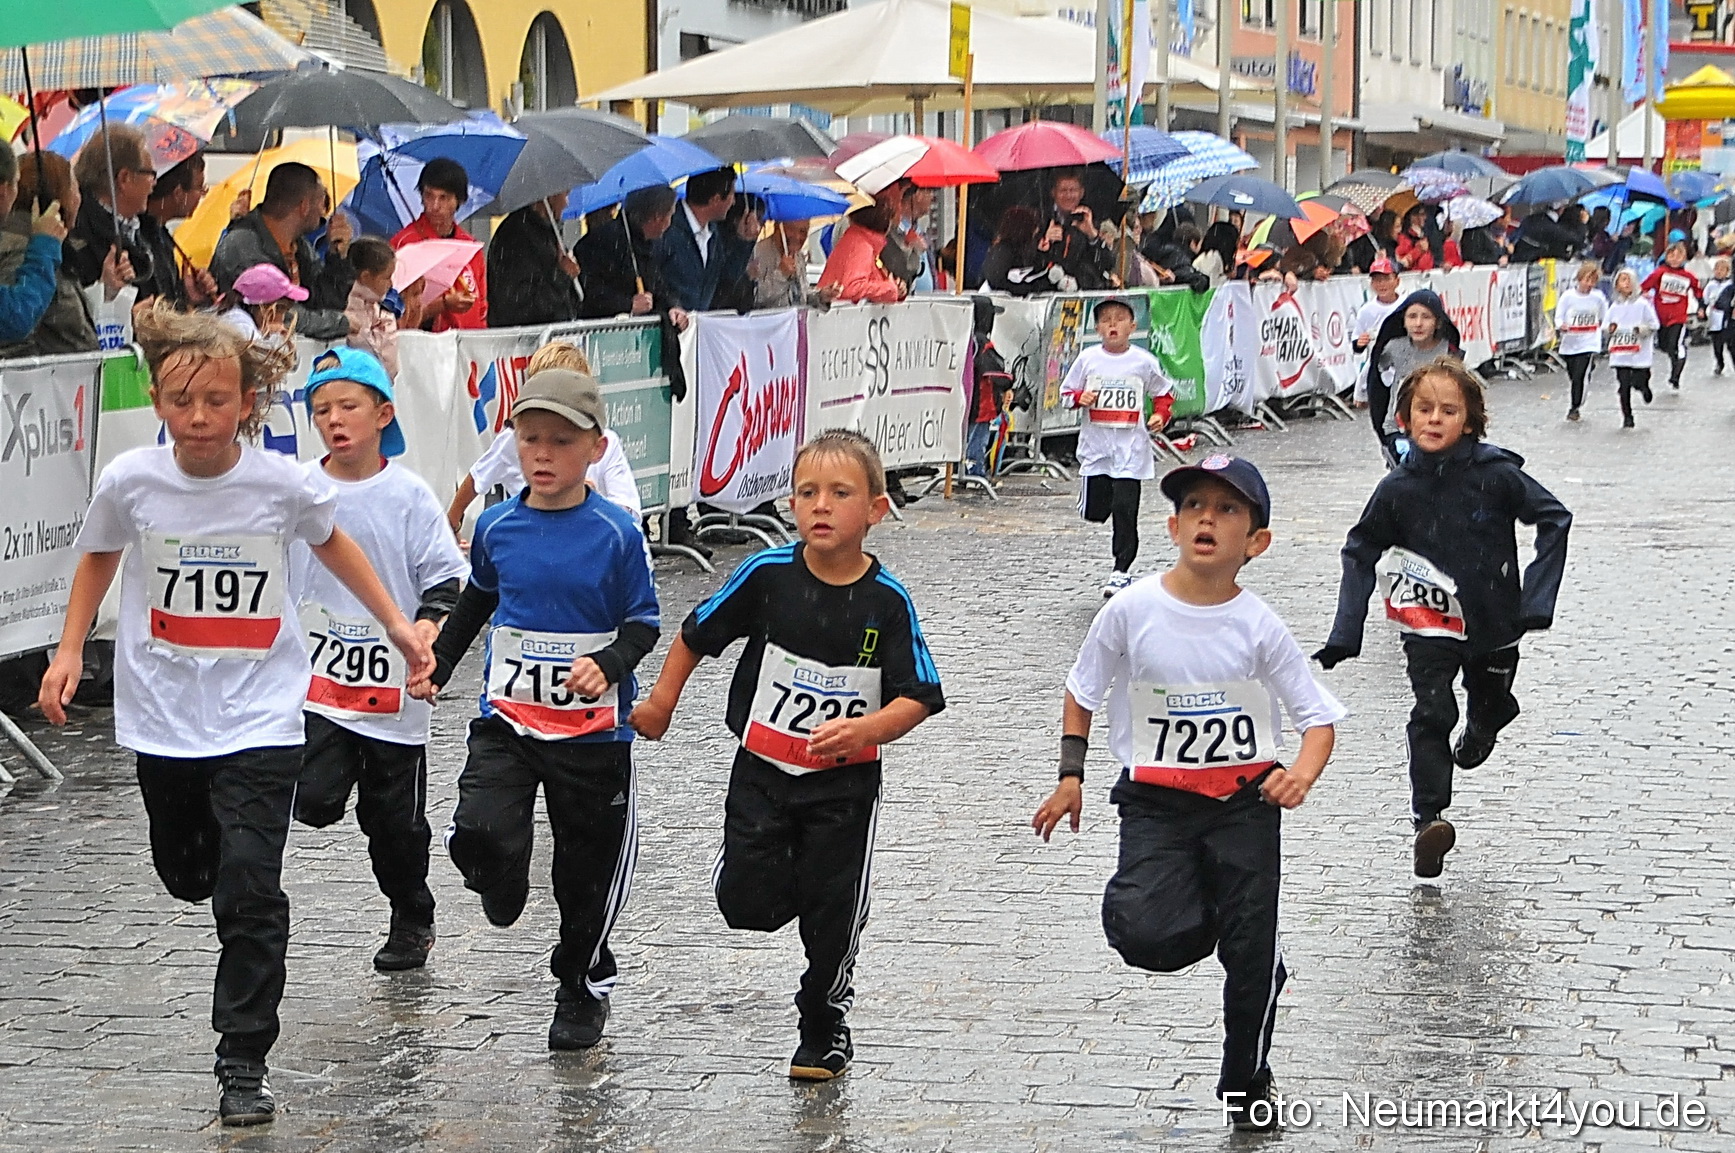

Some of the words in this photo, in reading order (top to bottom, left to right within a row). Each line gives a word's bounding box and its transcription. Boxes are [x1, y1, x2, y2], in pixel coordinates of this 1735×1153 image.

[822, 346, 864, 382] RECHTS
[1091, 389, 1137, 409] 7286
[1, 384, 84, 477] Xplus1
[4, 526, 20, 561] 2x
[22, 522, 33, 557] in
[179, 545, 241, 559] BOCK
[157, 566, 269, 615] 7197
[308, 630, 390, 684] 7296
[521, 638, 577, 655] BOCK
[504, 657, 601, 707] 715
[793, 667, 848, 689] BOCK
[1166, 690, 1226, 708] BOCK
[1147, 713, 1258, 765] 7229
